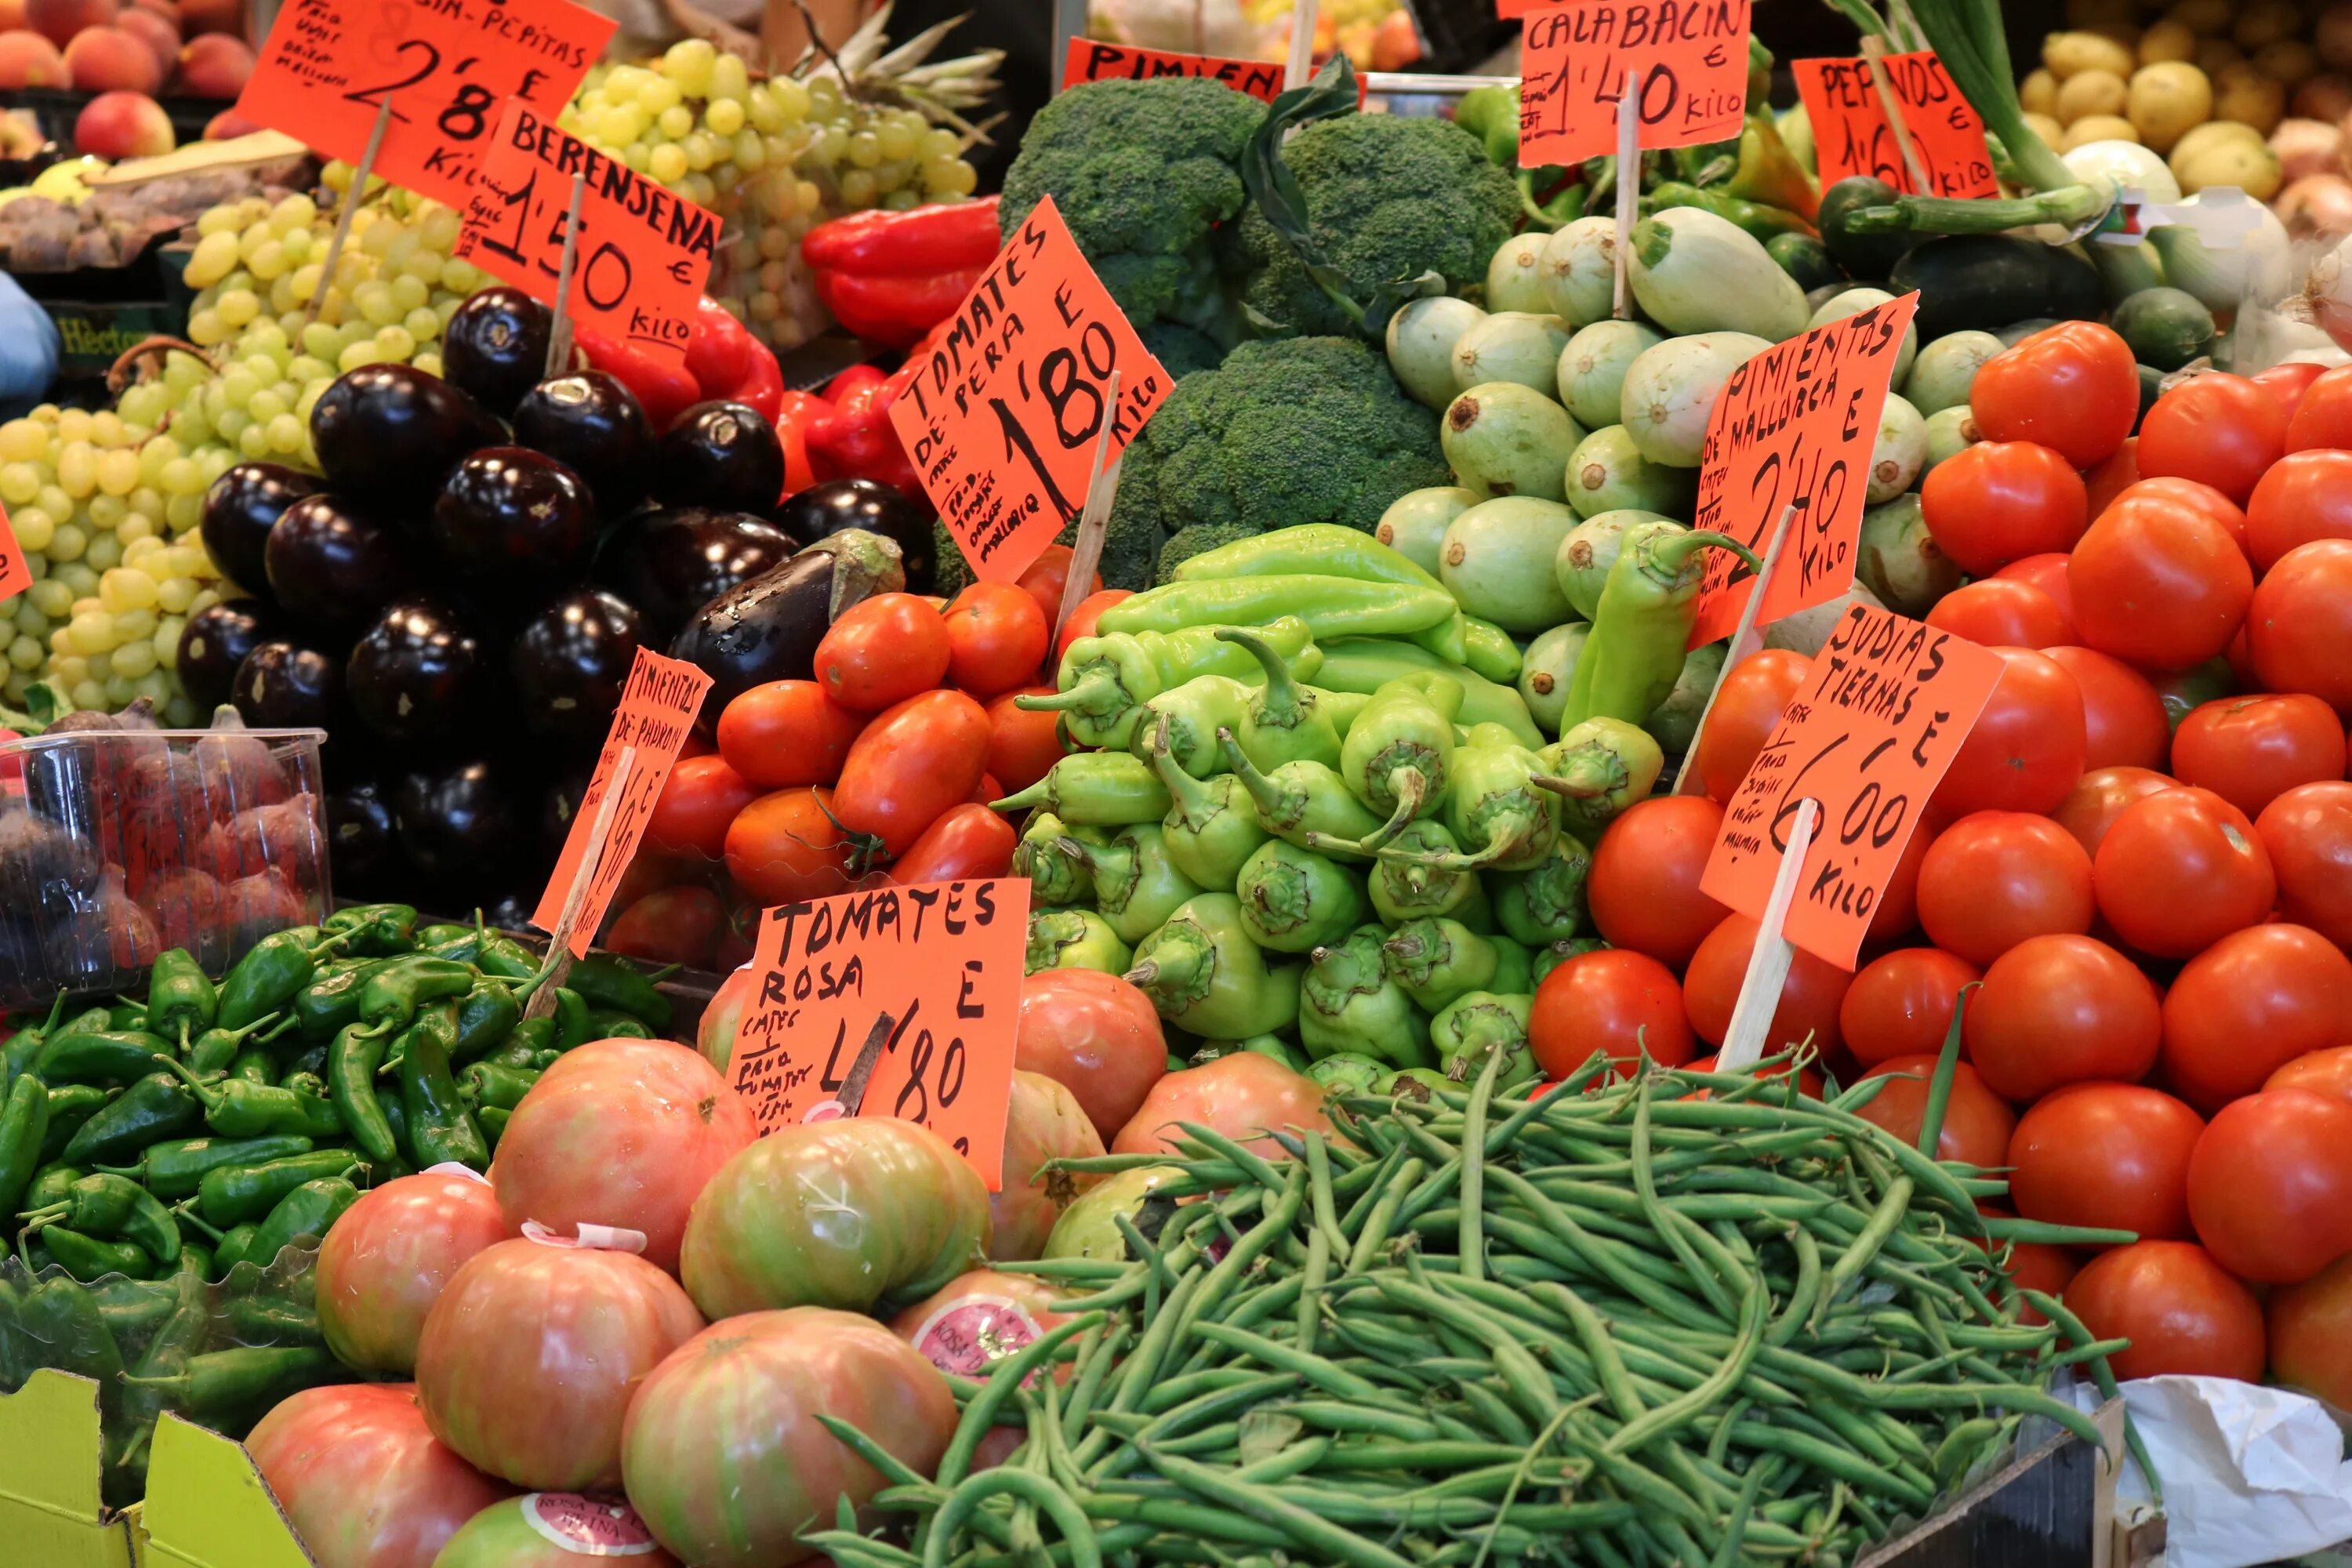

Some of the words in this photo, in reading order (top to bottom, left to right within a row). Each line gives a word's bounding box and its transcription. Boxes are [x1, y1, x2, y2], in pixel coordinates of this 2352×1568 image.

[1529, 0, 1743, 49] CALABACIN
[1086, 45, 1287, 95] PIMIEN
[1820, 57, 1948, 108] PEPNOS
[512, 110, 715, 261] BERENJENA
[900, 220, 1047, 420] TOMATES
[954, 312, 1025, 418] PERA
[1722, 306, 1898, 433] PIMIENTOS
[1729, 368, 1838, 464] MALLORCA
[1814, 656, 1919, 726] TIERNAS
[772, 881, 996, 967] TOMATES
[758, 954, 864, 1009] ROSA
